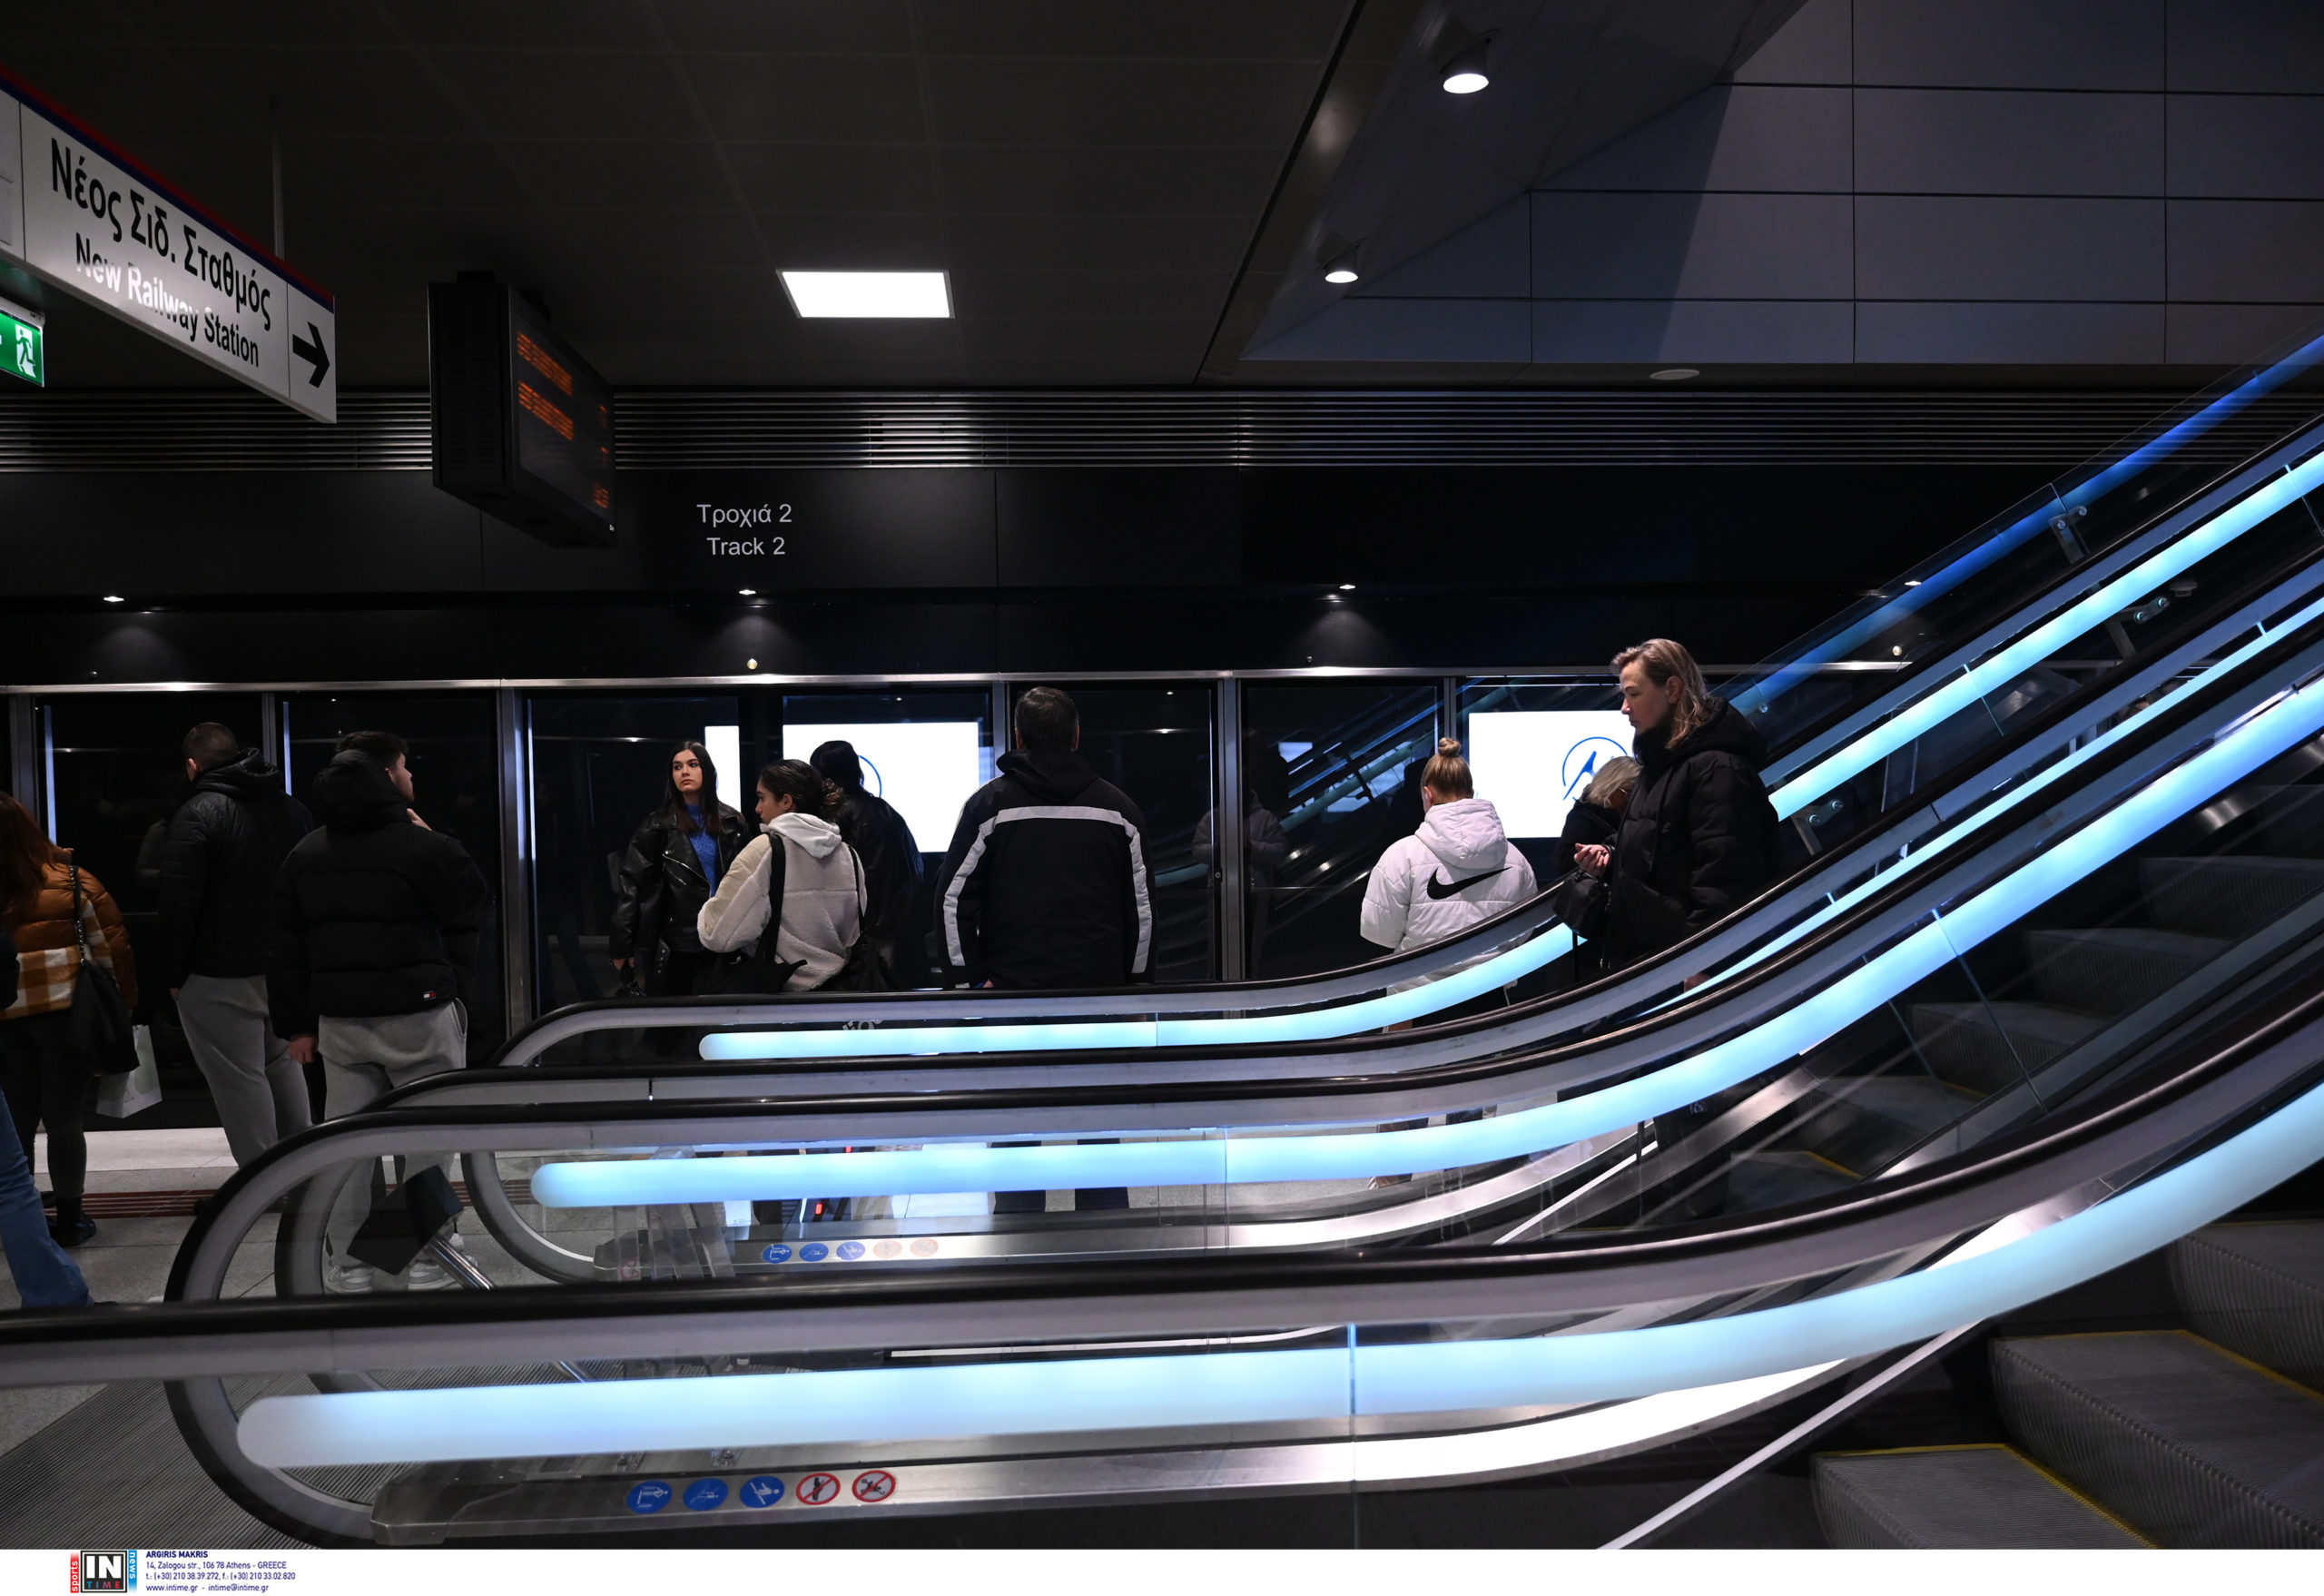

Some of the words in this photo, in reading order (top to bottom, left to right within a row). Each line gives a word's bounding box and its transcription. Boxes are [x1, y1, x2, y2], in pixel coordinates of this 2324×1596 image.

[52, 137, 123, 242] Νέος
[130, 189, 176, 263] Σιδ.
[183, 224, 271, 331] Σταθμός
[75, 232, 122, 292] New
[128, 261, 200, 342] Railway
[204, 307, 260, 368] Station
[696, 503, 772, 528] Τροχιά
[779, 503, 793, 523] 2
[706, 537, 764, 556] Track
[773, 537, 786, 555] 2
